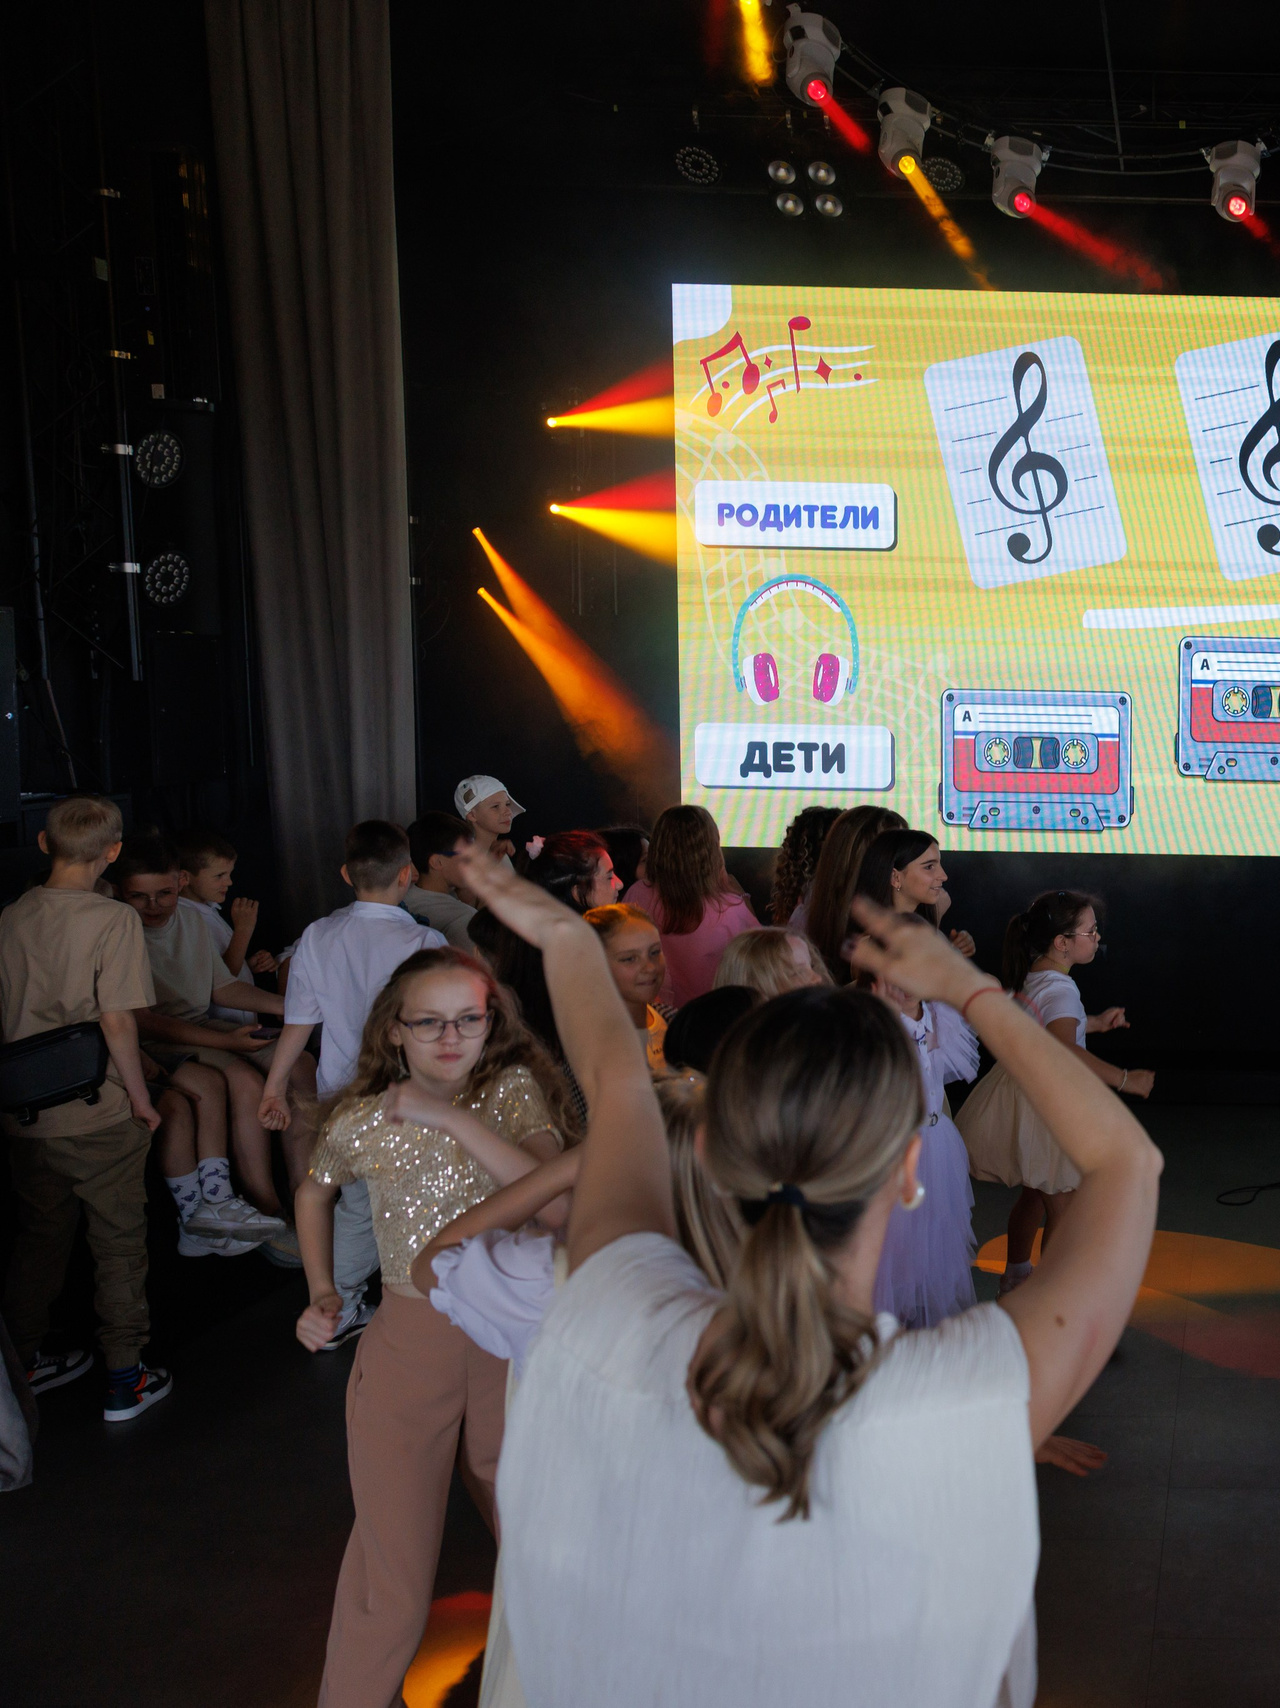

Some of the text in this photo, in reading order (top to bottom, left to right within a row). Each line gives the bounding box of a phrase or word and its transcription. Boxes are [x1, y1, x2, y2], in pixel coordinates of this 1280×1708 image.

[717, 503, 880, 533] РОДИТЕЛИ
[1200, 658, 1210, 671] A
[962, 710, 972, 722] A
[739, 741, 846, 779] ДЕТИ
